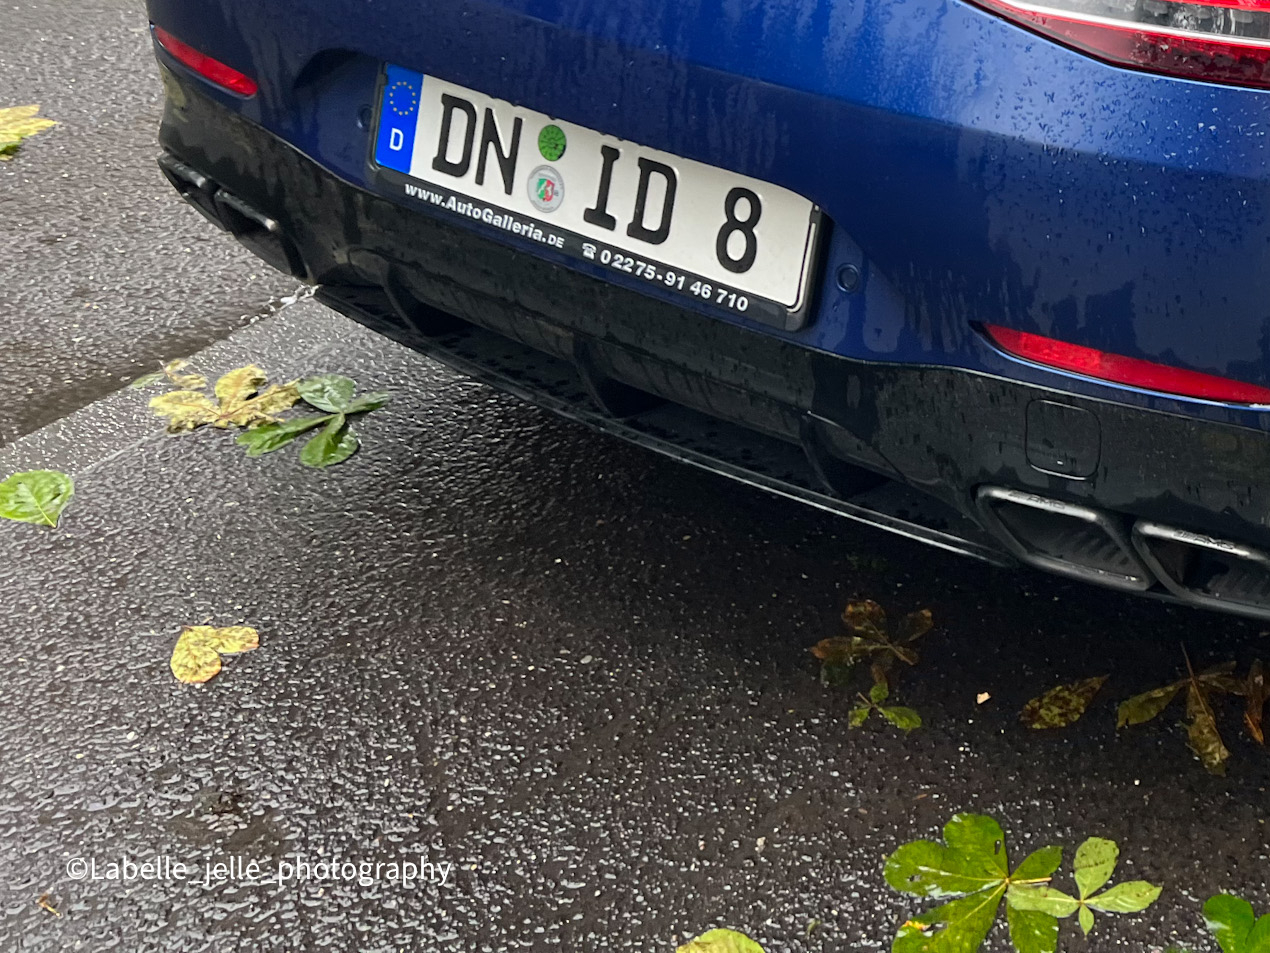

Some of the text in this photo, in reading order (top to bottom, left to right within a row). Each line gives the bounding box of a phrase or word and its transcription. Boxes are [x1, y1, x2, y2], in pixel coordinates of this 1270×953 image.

[389, 127, 404, 151] D
[432, 93, 523, 196] DN
[583, 144, 678, 245] ID
[715, 186, 762, 274] 8
[690, 279, 713, 300] 46
[715, 288, 749, 312] 710
